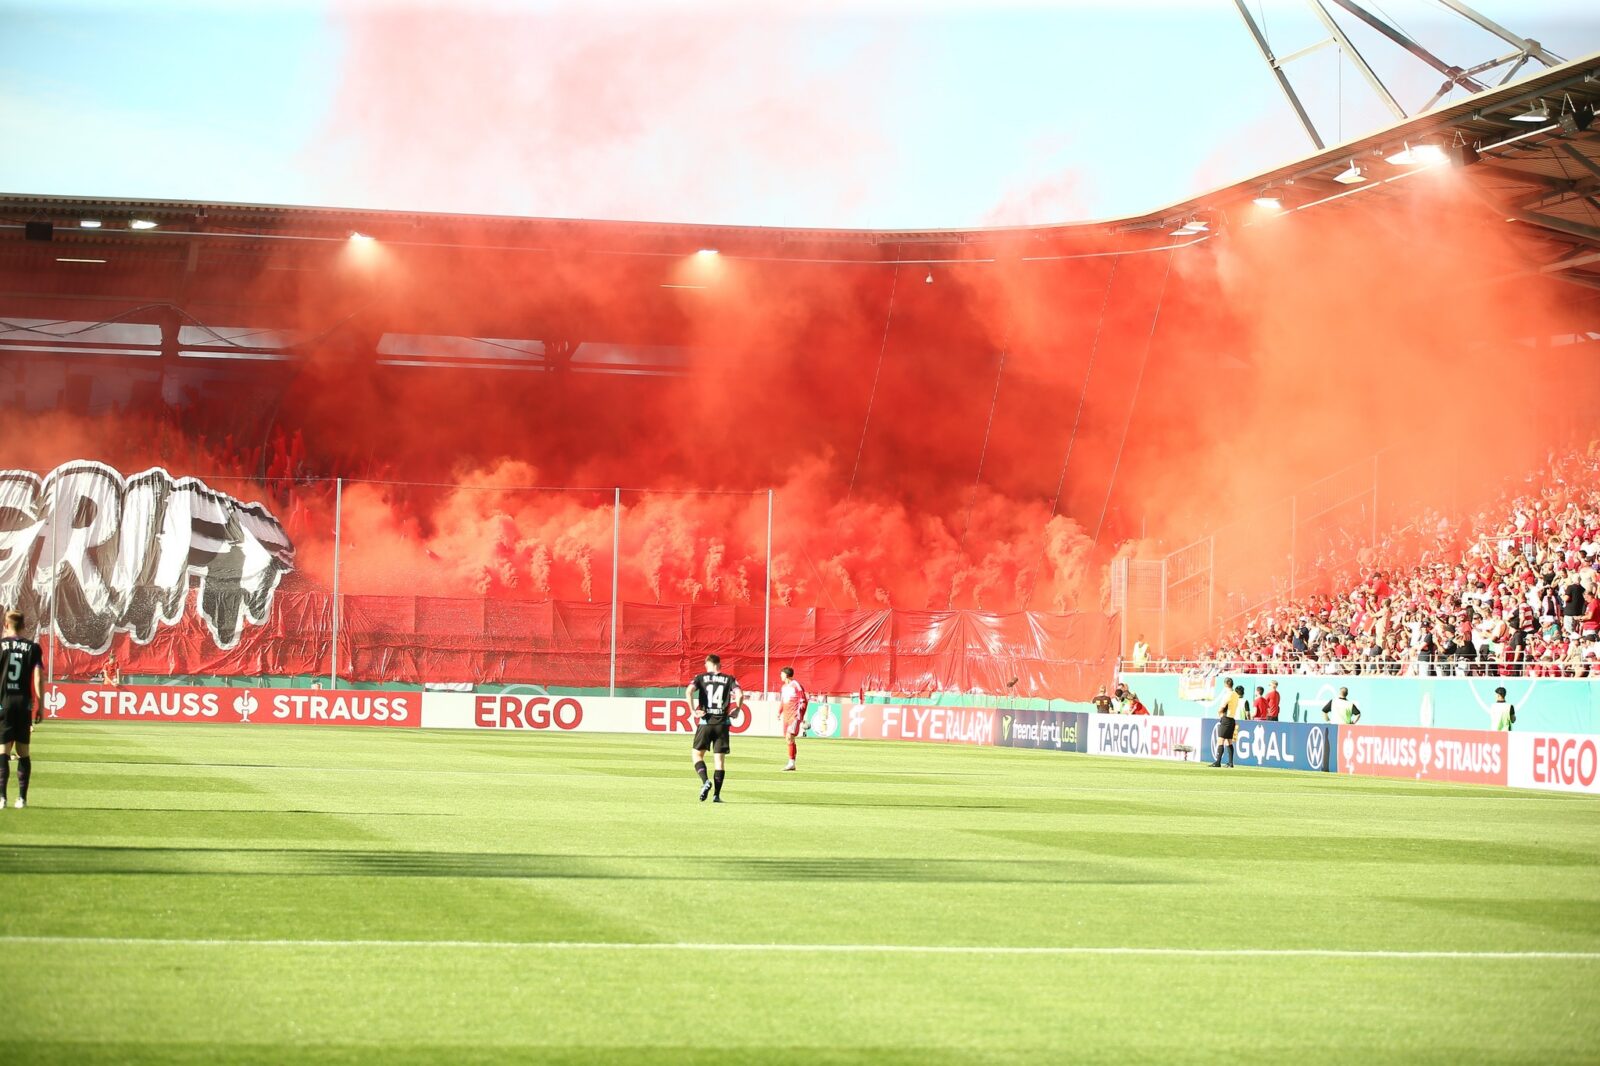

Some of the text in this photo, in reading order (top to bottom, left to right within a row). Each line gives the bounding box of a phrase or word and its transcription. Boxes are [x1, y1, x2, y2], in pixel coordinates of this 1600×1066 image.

[8, 652, 22, 681] 5
[80, 690, 219, 717] STRAUSS
[272, 695, 409, 721] STRAUSS
[706, 684, 724, 708] 14
[474, 695, 583, 729] ERGO
[644, 700, 752, 733] ERO
[881, 709, 993, 744] FLYERALARM
[1061, 721, 1077, 744] los!
[1356, 736, 1418, 767] STRAUSS
[1434, 741, 1501, 774] STRAUSS
[1533, 738, 1598, 787] ERGO
